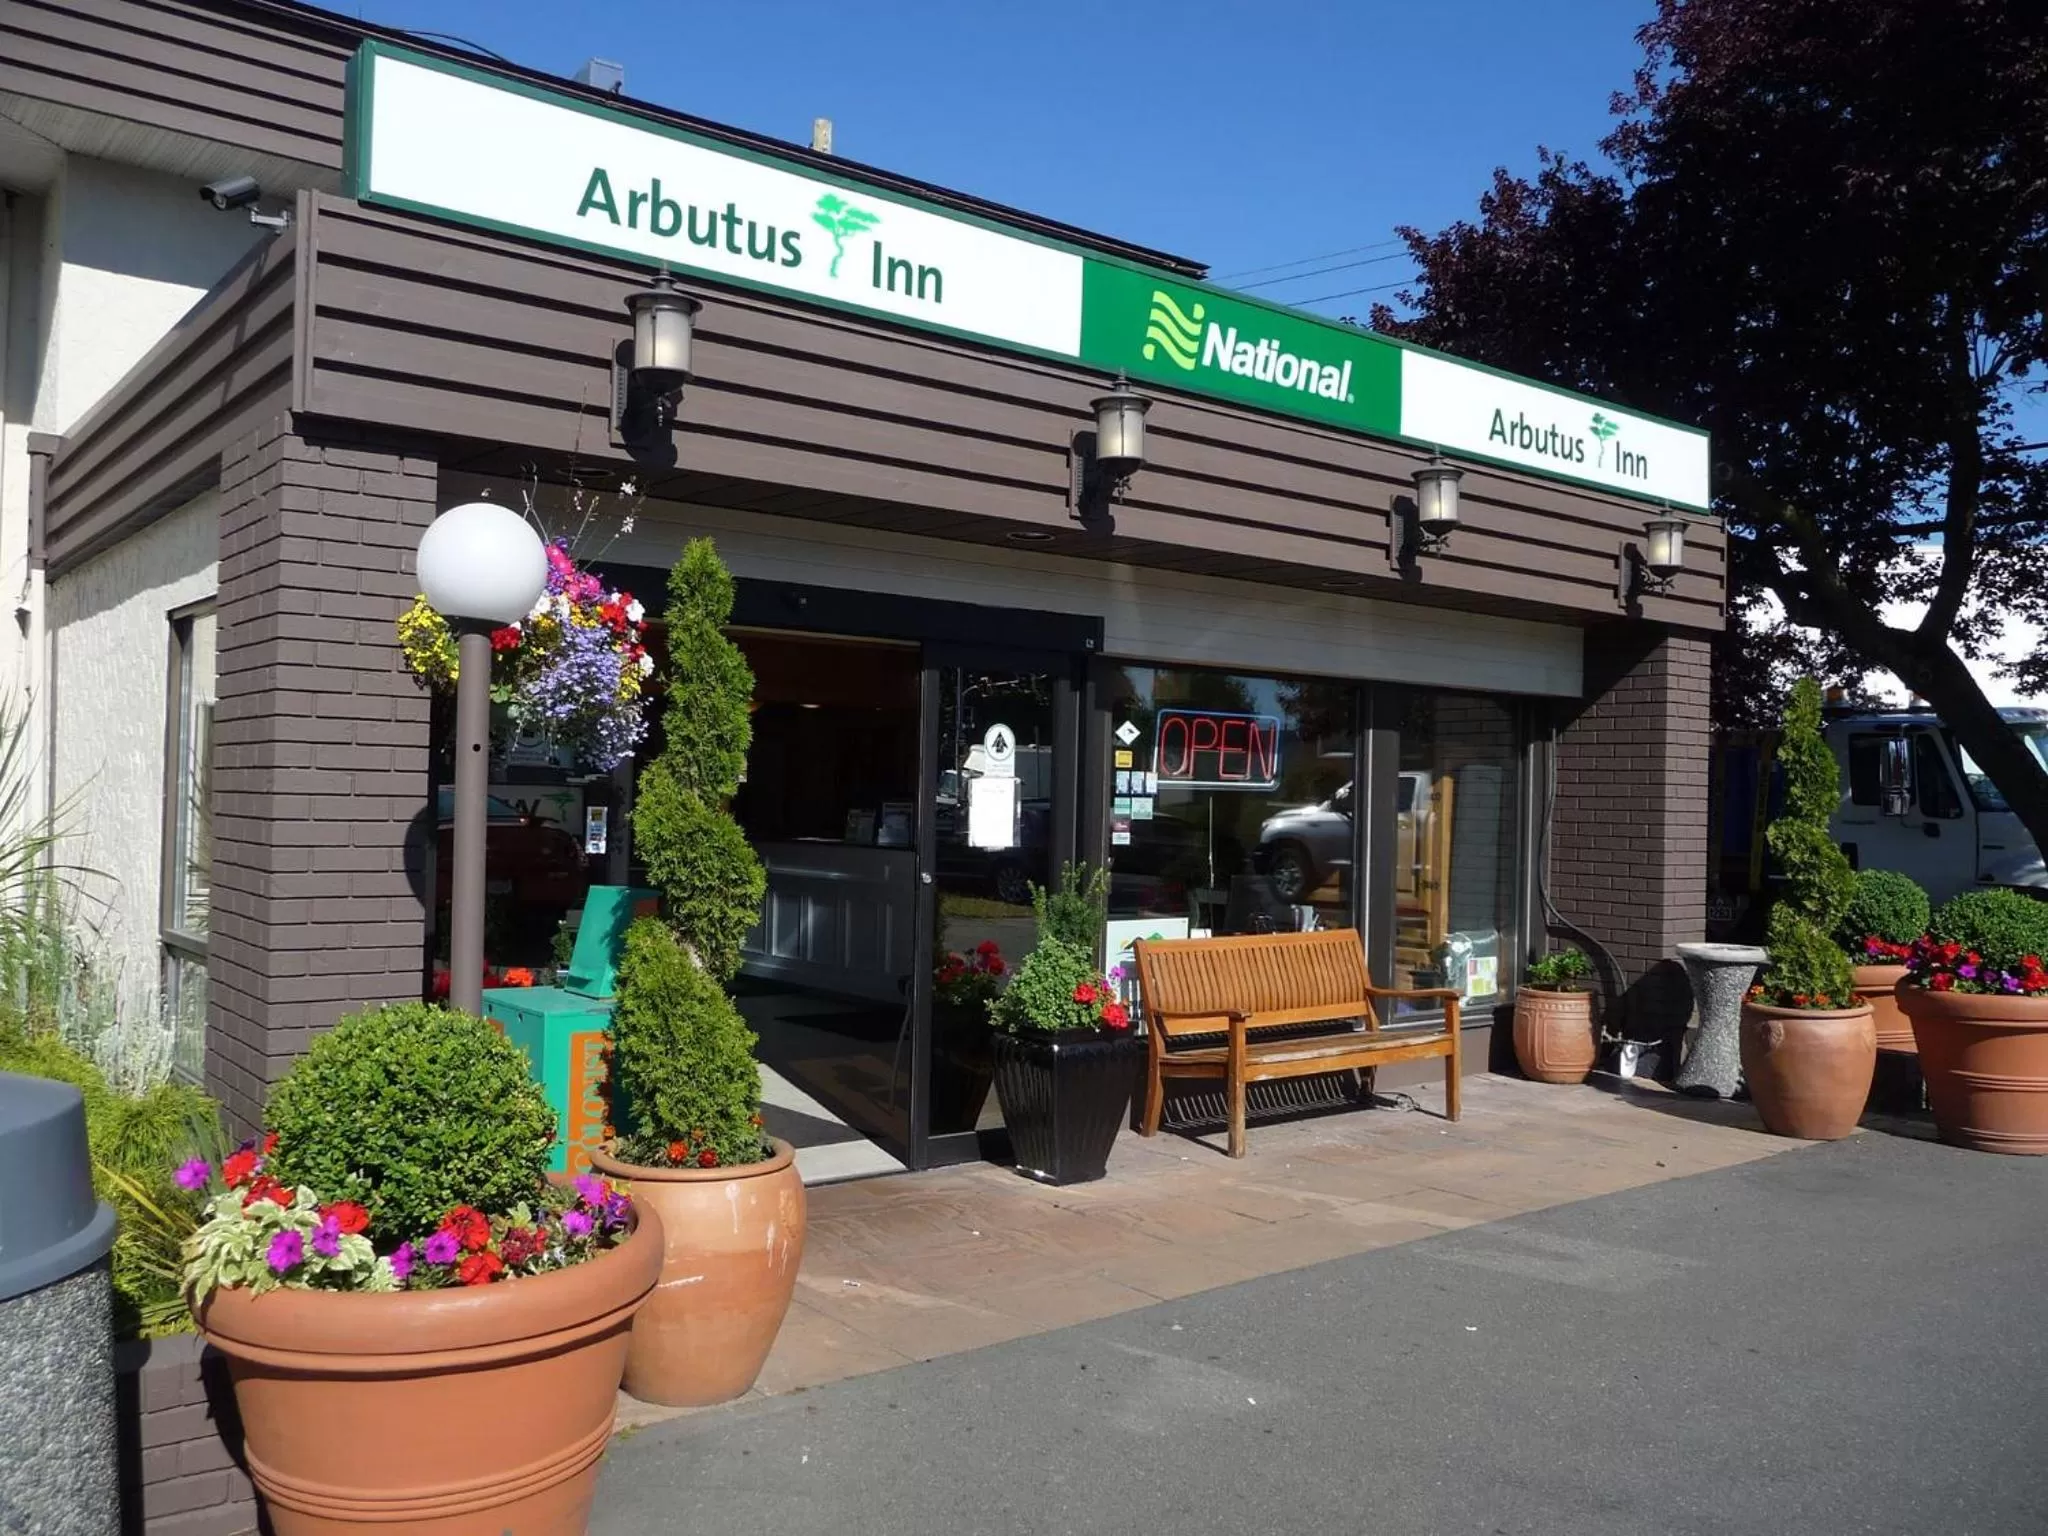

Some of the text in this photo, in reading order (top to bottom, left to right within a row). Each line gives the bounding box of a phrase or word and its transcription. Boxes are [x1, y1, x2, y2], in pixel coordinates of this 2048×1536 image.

[577, 167, 943, 304] Arbutus Inn
[1488, 407, 1648, 480] Arbutus Inn
[1159, 716, 1277, 781] OPEN
